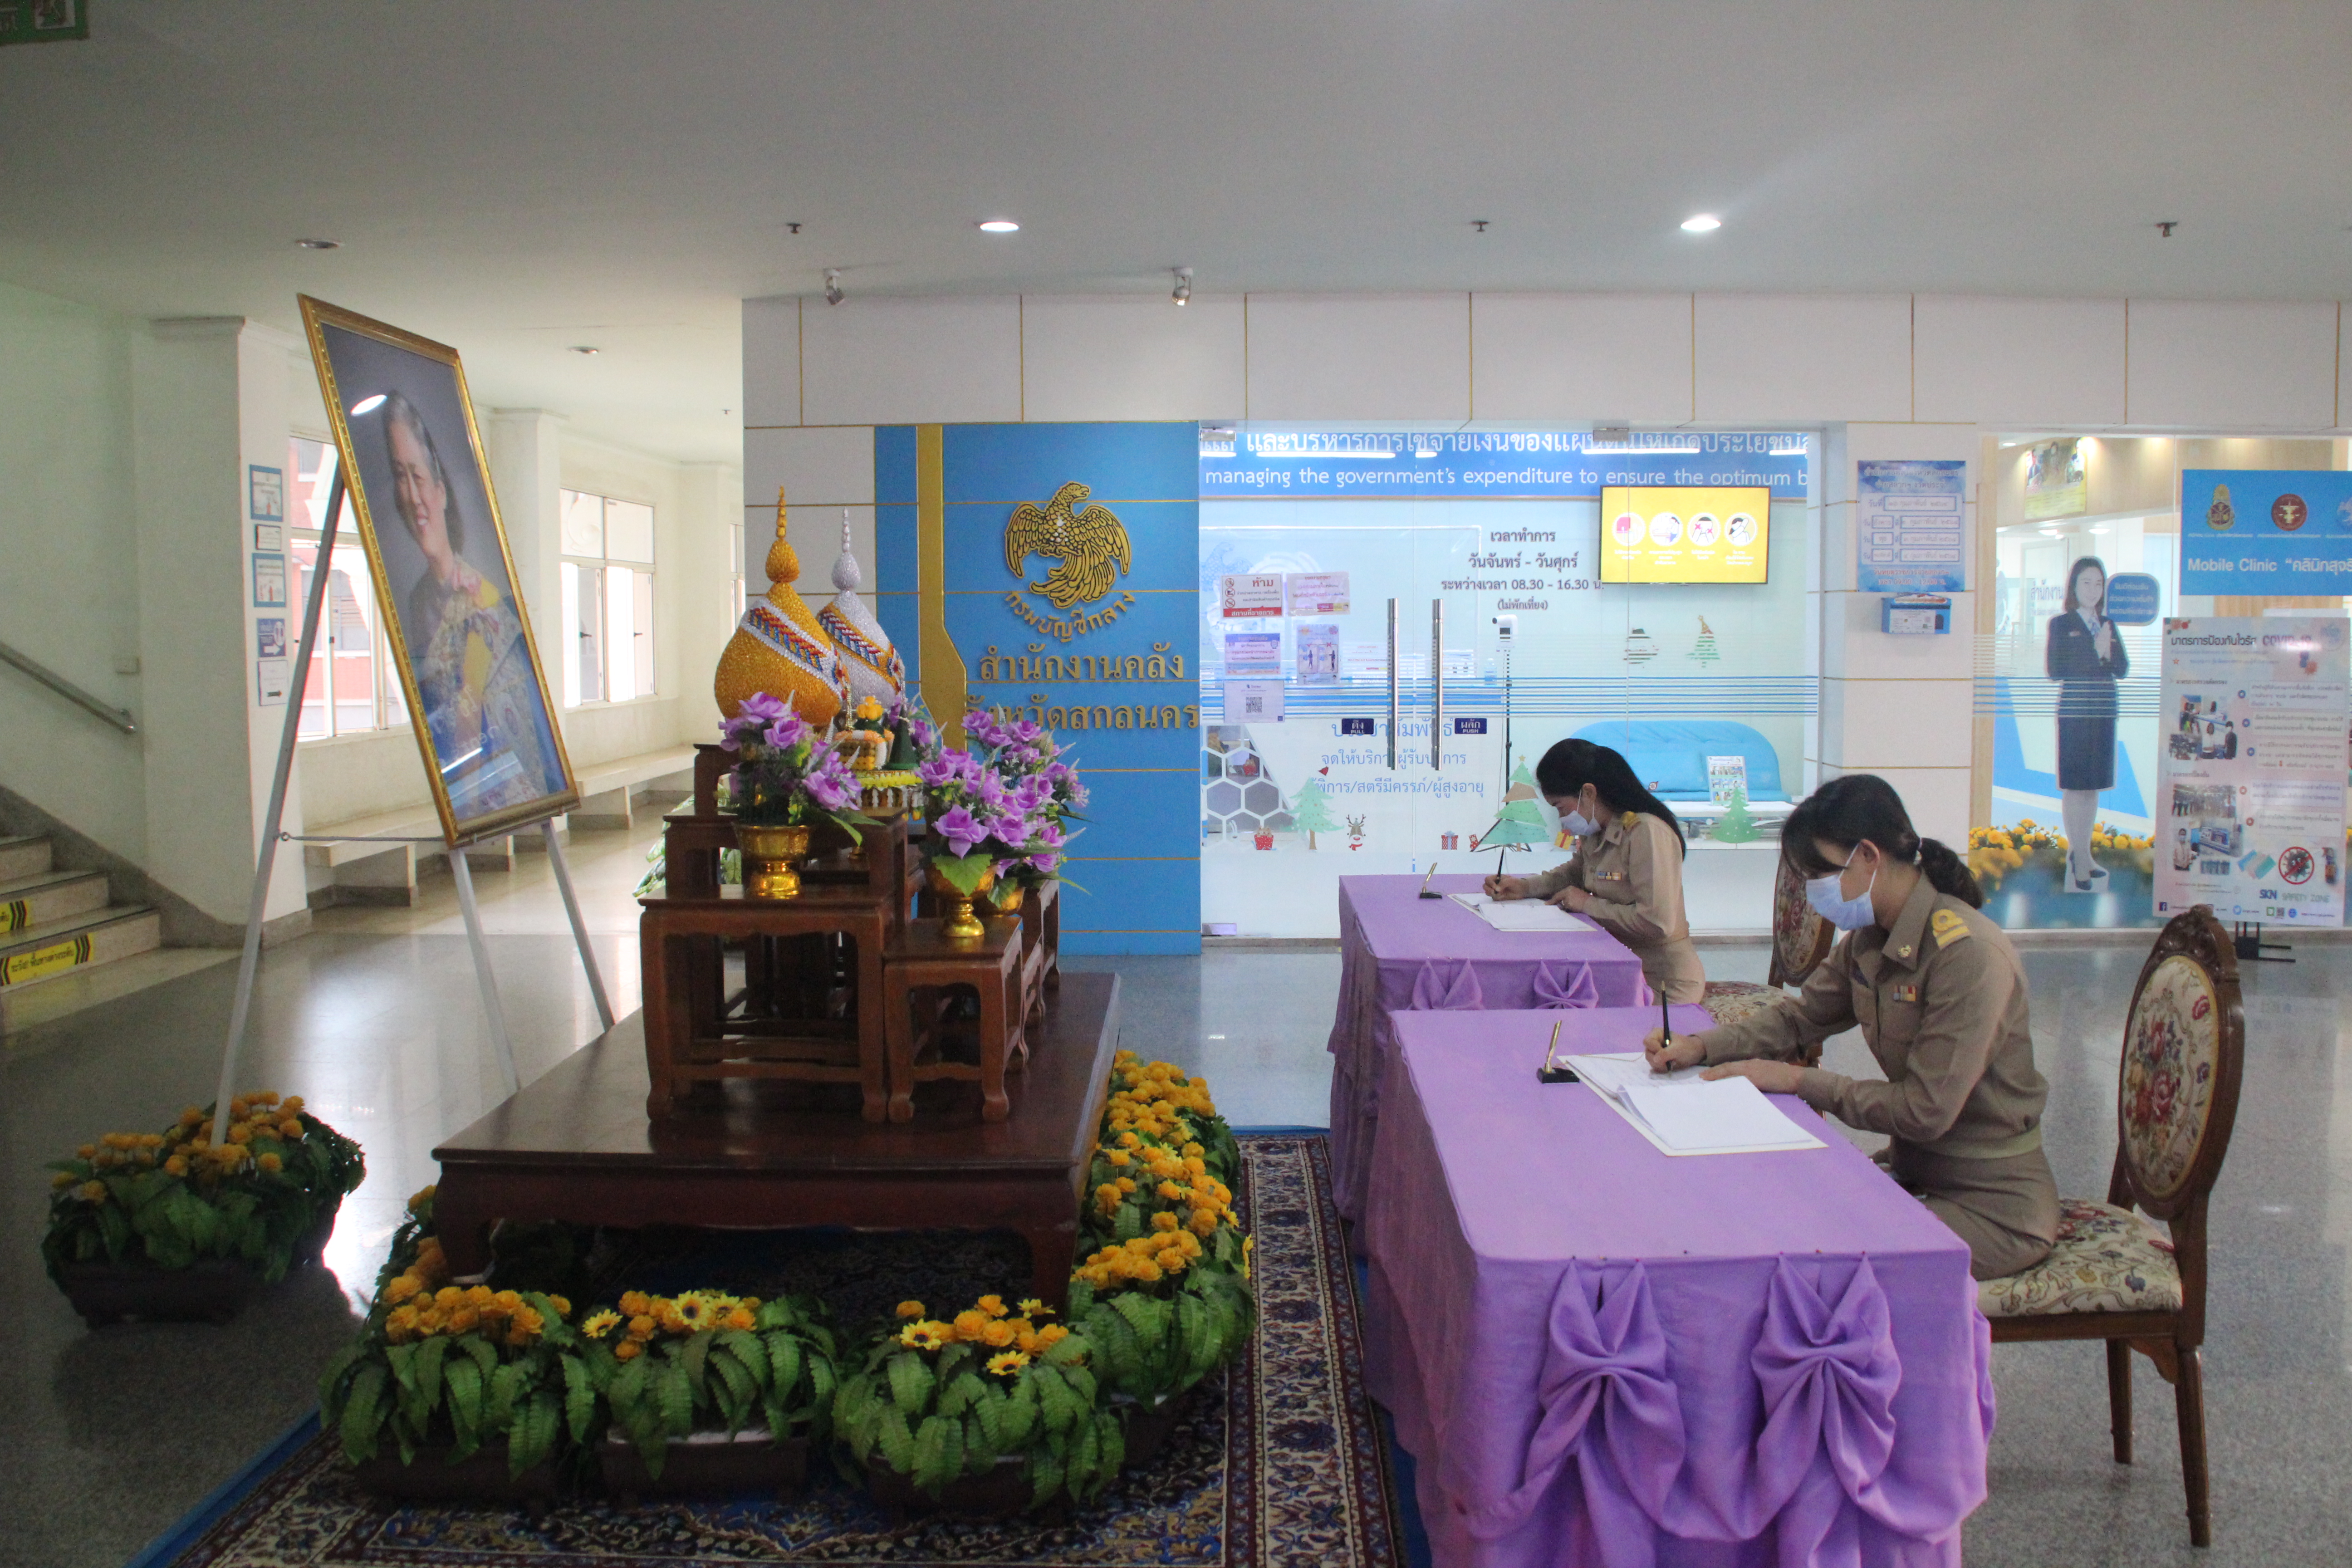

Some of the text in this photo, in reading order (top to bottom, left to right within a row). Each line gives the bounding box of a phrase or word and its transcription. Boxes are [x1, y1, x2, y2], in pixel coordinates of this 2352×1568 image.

[1205, 468, 1291, 487] managing
[1299, 467, 1329, 484] the
[1463, 468, 1573, 487] expenditure
[1579, 469, 1598, 484] to
[1606, 470, 1666, 484] ensure
[1674, 468, 1704, 484] the
[1710, 469, 1790, 485] optimum
[1490, 527, 1556, 542] เวลาทำการ
[1469, 551, 1523, 568] วันจันทร์
[1535, 551, 1579, 573] วันศุกร์
[2188, 558, 2234, 571] Mobile
[2239, 558, 2277, 572] Clinic
[1252, 577, 1274, 587] ห้าม
[1441, 577, 1507, 590] ระหว่างเวลา
[1511, 579, 1544, 590] 08.30
[1557, 579, 1588, 590] 16.30
[1498, 596, 1548, 610] (ไม่พักเที่ยง)
[1004, 591, 1136, 643] กรมบัญชีกลาง
[980, 642, 1185, 680] สำนักงานคลัง
[1461, 719, 1480, 729] ผลัก
[2259, 889, 2278, 901] SKN
